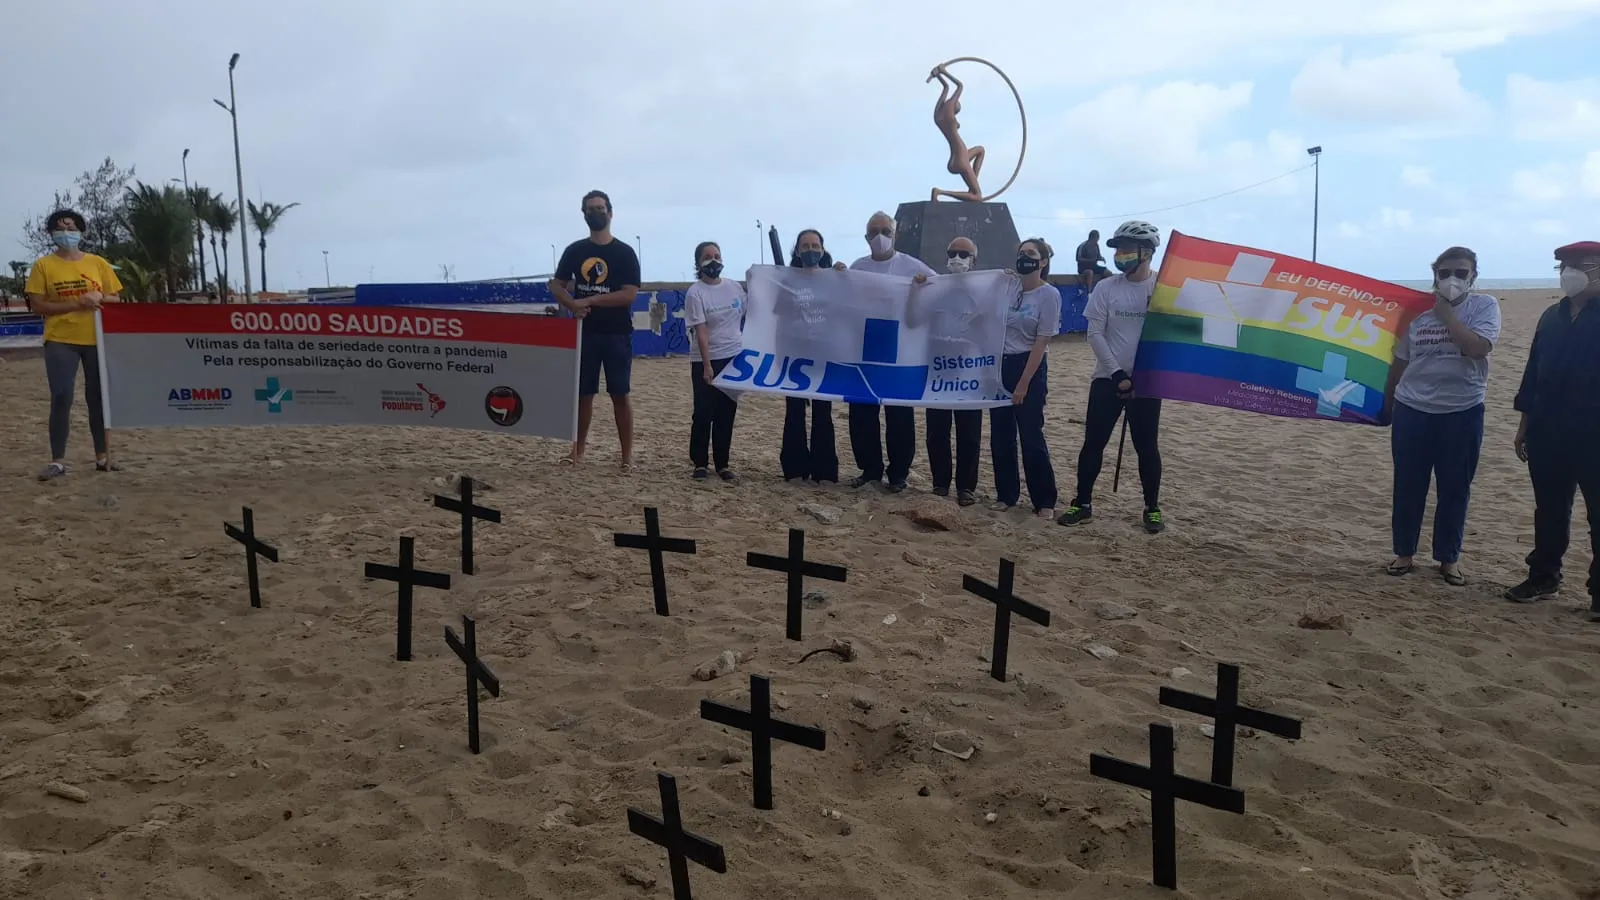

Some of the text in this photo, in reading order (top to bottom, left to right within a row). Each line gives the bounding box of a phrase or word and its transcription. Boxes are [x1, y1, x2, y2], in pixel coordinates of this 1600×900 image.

[1276, 272, 1398, 312] EU DEFENDO O
[230, 311, 464, 337] 600.000 SAUDADES
[1287, 297, 1386, 346] SUS
[185, 337, 508, 359] Vítimas da falta de seriedade contra a pandemia
[203, 354, 495, 374] Pela responsabilização do Governo Federal
[722, 349, 814, 391] SUS
[933, 354, 996, 371] Sistema
[168, 388, 232, 401] ABMMD
[931, 375, 980, 392] Único
[1240, 382, 1312, 404] Coletivo Rebento
